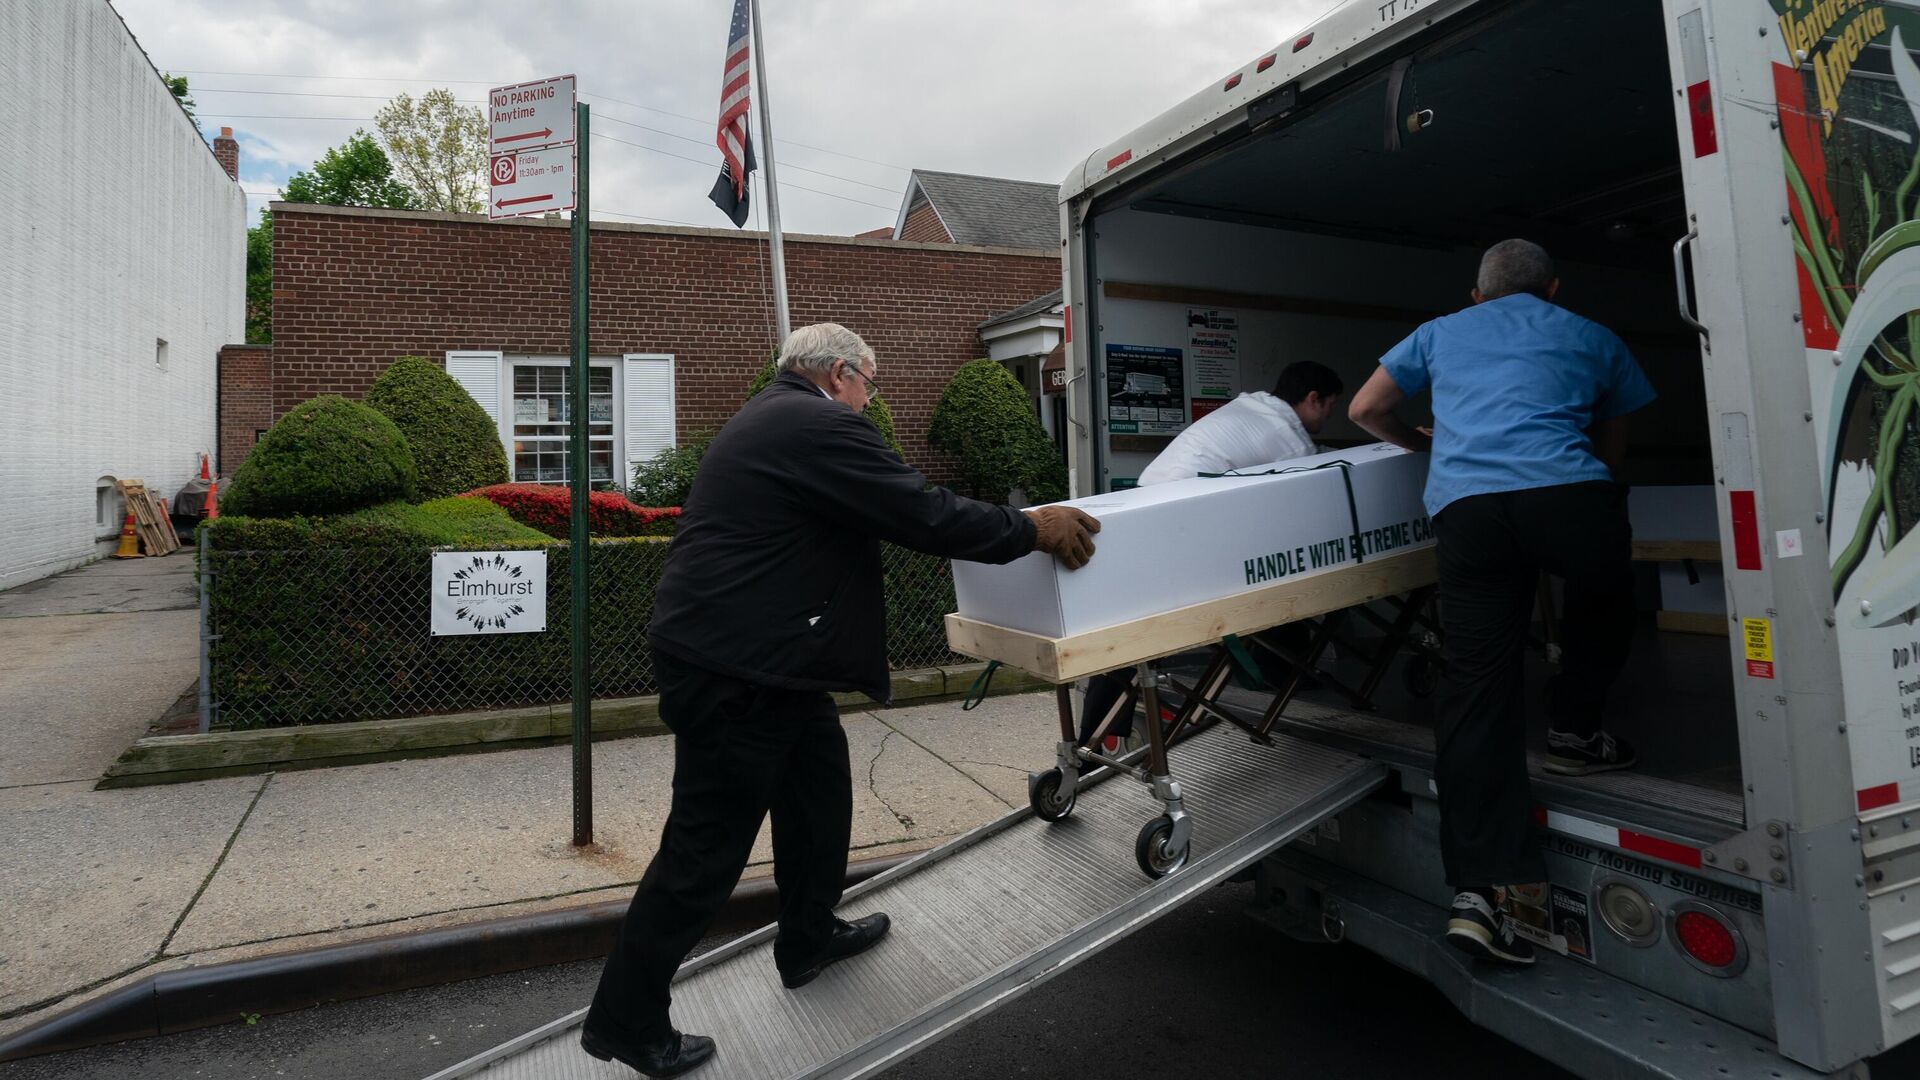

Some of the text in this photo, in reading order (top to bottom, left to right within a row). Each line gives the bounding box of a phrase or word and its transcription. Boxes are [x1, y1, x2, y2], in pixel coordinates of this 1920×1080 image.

[1812, 6, 1886, 139] America
[494, 86, 555, 108] NO PARKING
[494, 107, 536, 123] Anytime
[518, 155, 539, 165] Friday
[519, 167, 545, 178] 11:30am
[551, 164, 564, 176] 1pm
[1244, 516, 1435, 585] HANDLE WITH EXTREME CA
[447, 579, 533, 597] Elmhurst
[1557, 836, 1591, 859] Your
[1598, 849, 1663, 885] Moving
[1669, 869, 1762, 911] Supplies
